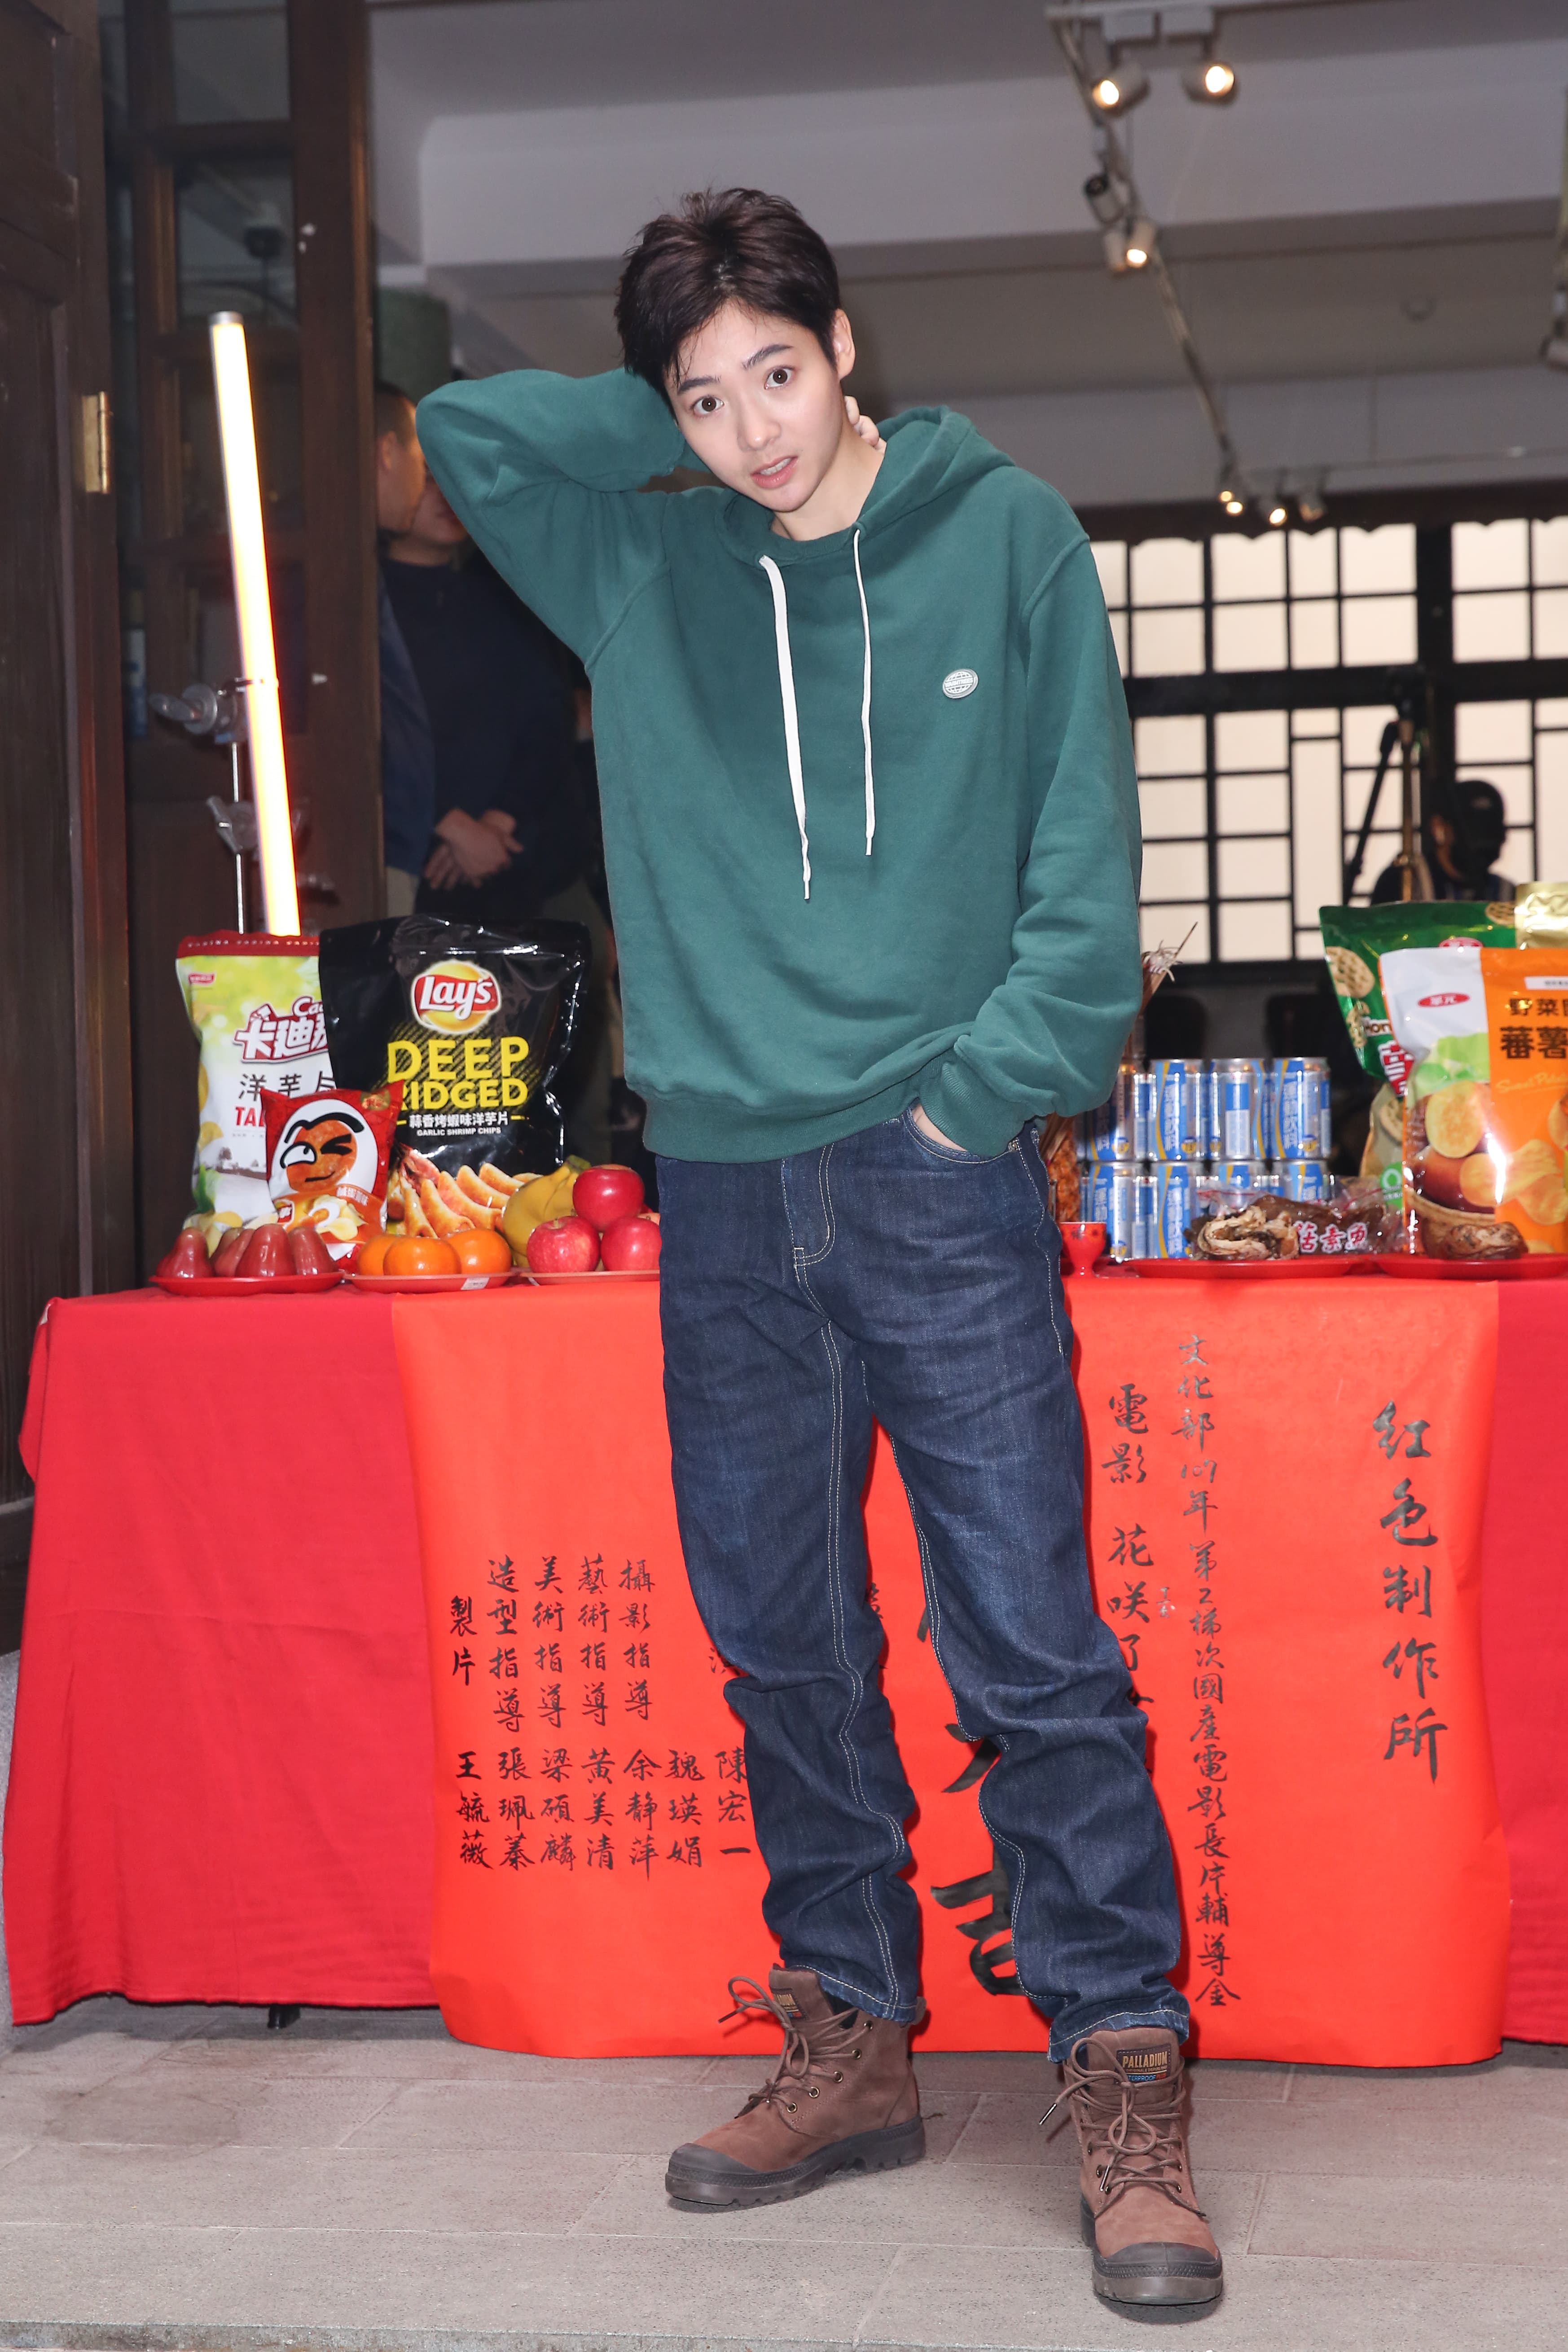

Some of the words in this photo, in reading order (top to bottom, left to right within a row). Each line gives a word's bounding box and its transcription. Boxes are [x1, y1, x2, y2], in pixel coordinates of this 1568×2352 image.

[419, 976, 493, 1020] Lay's
[387, 1036, 530, 1082] DEEP
[446, 1128, 477, 1136] SHRIMP
[1101, 1383, 1150, 1484] 電影
[449, 1595, 478, 1686] 製片
[487, 1554, 525, 1732] 造型指導
[533, 1555, 567, 1728] 美術指導
[618, 1558, 655, 1720] 攝影指導
[714, 1745, 751, 1855] 陳宏一
[1122, 2051, 1168, 2068] PALLADIUM
